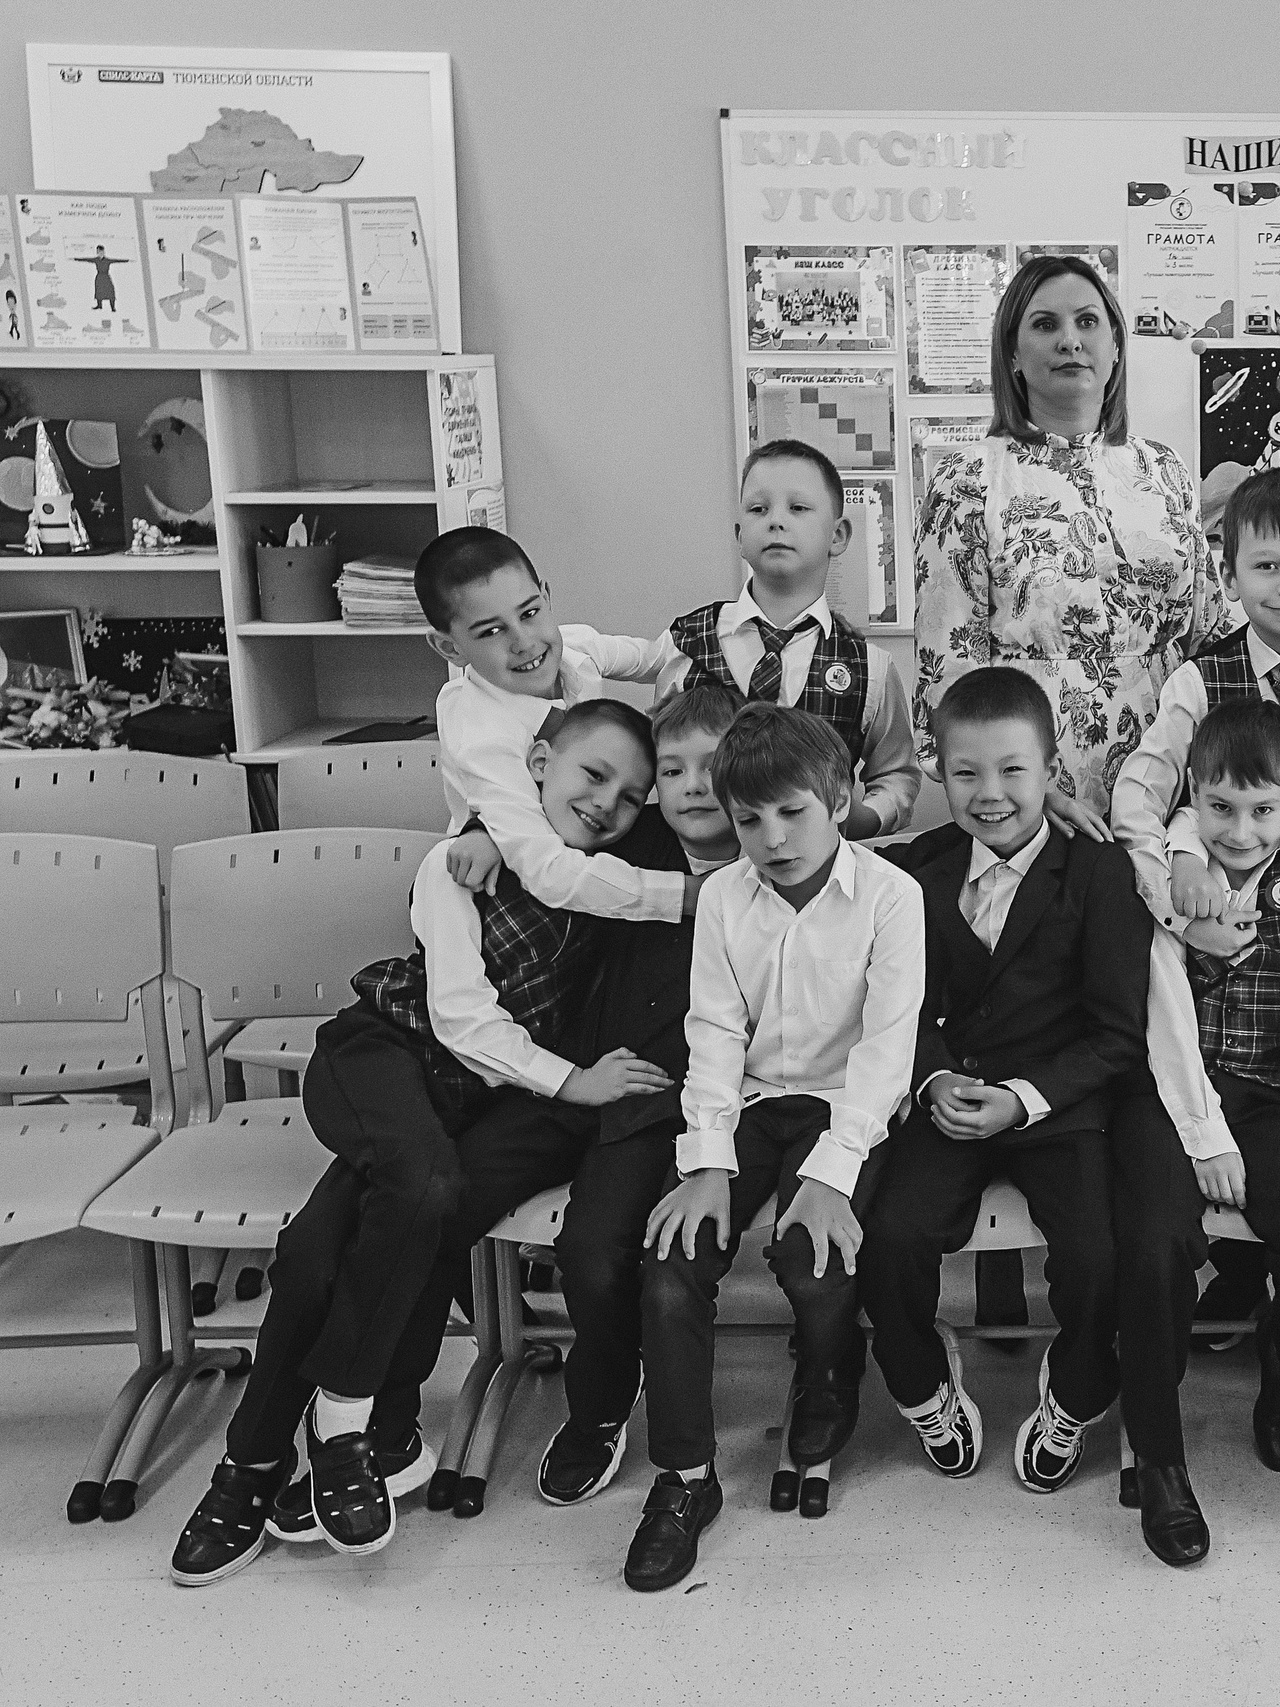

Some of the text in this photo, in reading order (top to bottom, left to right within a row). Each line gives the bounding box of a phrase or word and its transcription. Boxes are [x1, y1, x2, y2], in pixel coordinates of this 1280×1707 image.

[173, 72, 252, 85] ТЮМЕНСКОЙ
[256, 75, 314, 87] ОБЛАСТИ
[761, 186, 978, 222] УГОЛОК
[1147, 233, 1216, 244] ГРАМОТА
[815, 261, 844, 269] КЛАСС
[781, 375, 865, 384] ГРАФИК ДЕЖУРСТВ
